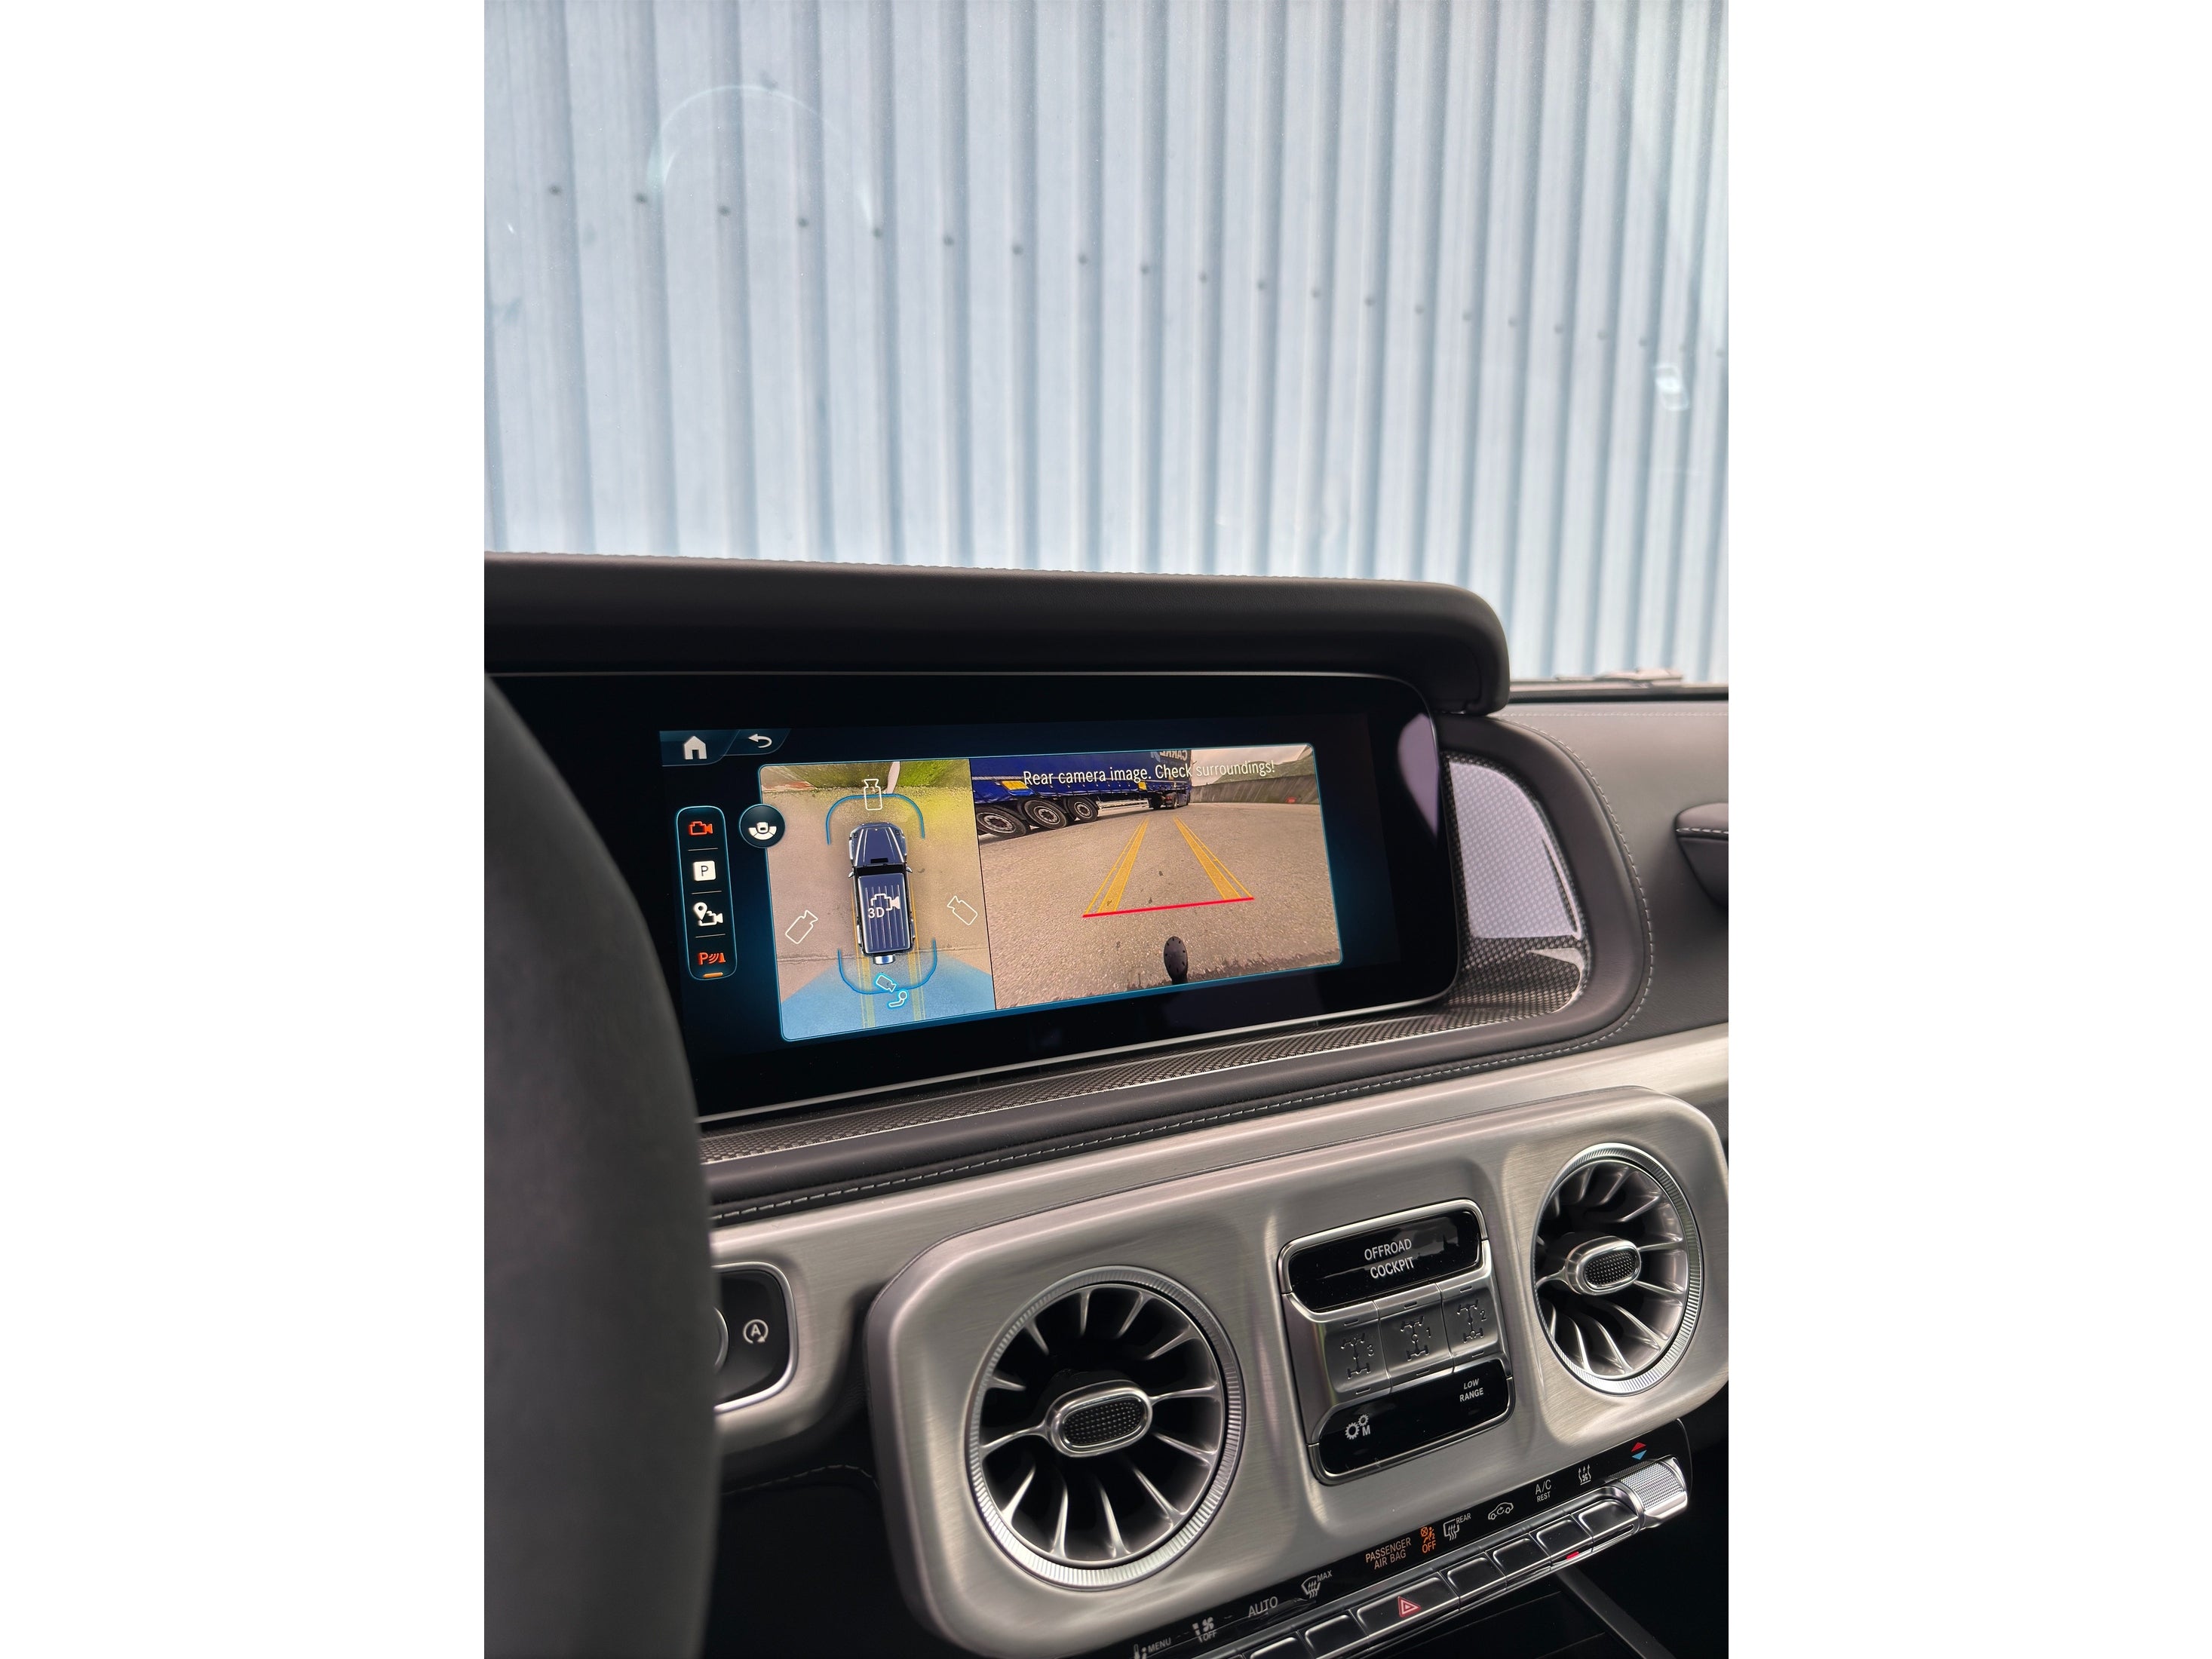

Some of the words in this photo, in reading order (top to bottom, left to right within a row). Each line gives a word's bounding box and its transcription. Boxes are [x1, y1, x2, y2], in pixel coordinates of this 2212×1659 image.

[1023, 771, 1054, 786] Rear
[1058, 771, 1106, 784] camera
[1109, 766, 1152, 784] image.
[1155, 763, 1192, 779] Check
[1196, 760, 1275, 777] surroundings!
[701, 865, 709, 877] P
[867, 906, 885, 919] 3D
[1364, 1238, 1412, 1261] OFFROAD
[1370, 1256, 1414, 1279] COCKPIT
[1480, 1309, 1487, 1322] 2
[750, 1324, 761, 1336] A
[1426, 1326, 1431, 1338] 1
[1367, 1345, 1375, 1356] 3
[1463, 1378, 1480, 1390] LOW
[1459, 1387, 1484, 1402] RANGE
[1362, 1424, 1370, 1437] M
[1536, 1479, 1551, 1495] A/C
[1536, 1491, 1551, 1502] REST
[1456, 1513, 1471, 1524] REAR
[1365, 1537, 1412, 1562] PASSENGER
[1422, 1540, 1437, 1553] OFF
[1374, 1557, 1388, 1569] AIR
[1390, 1549, 1407, 1563] BAG
[1317, 1569, 1333, 1582] MAX
[1248, 1596, 1278, 1618] AUTO
[1202, 1630, 1217, 1641] OFF
[1147, 1637, 1171, 1653] MENU
